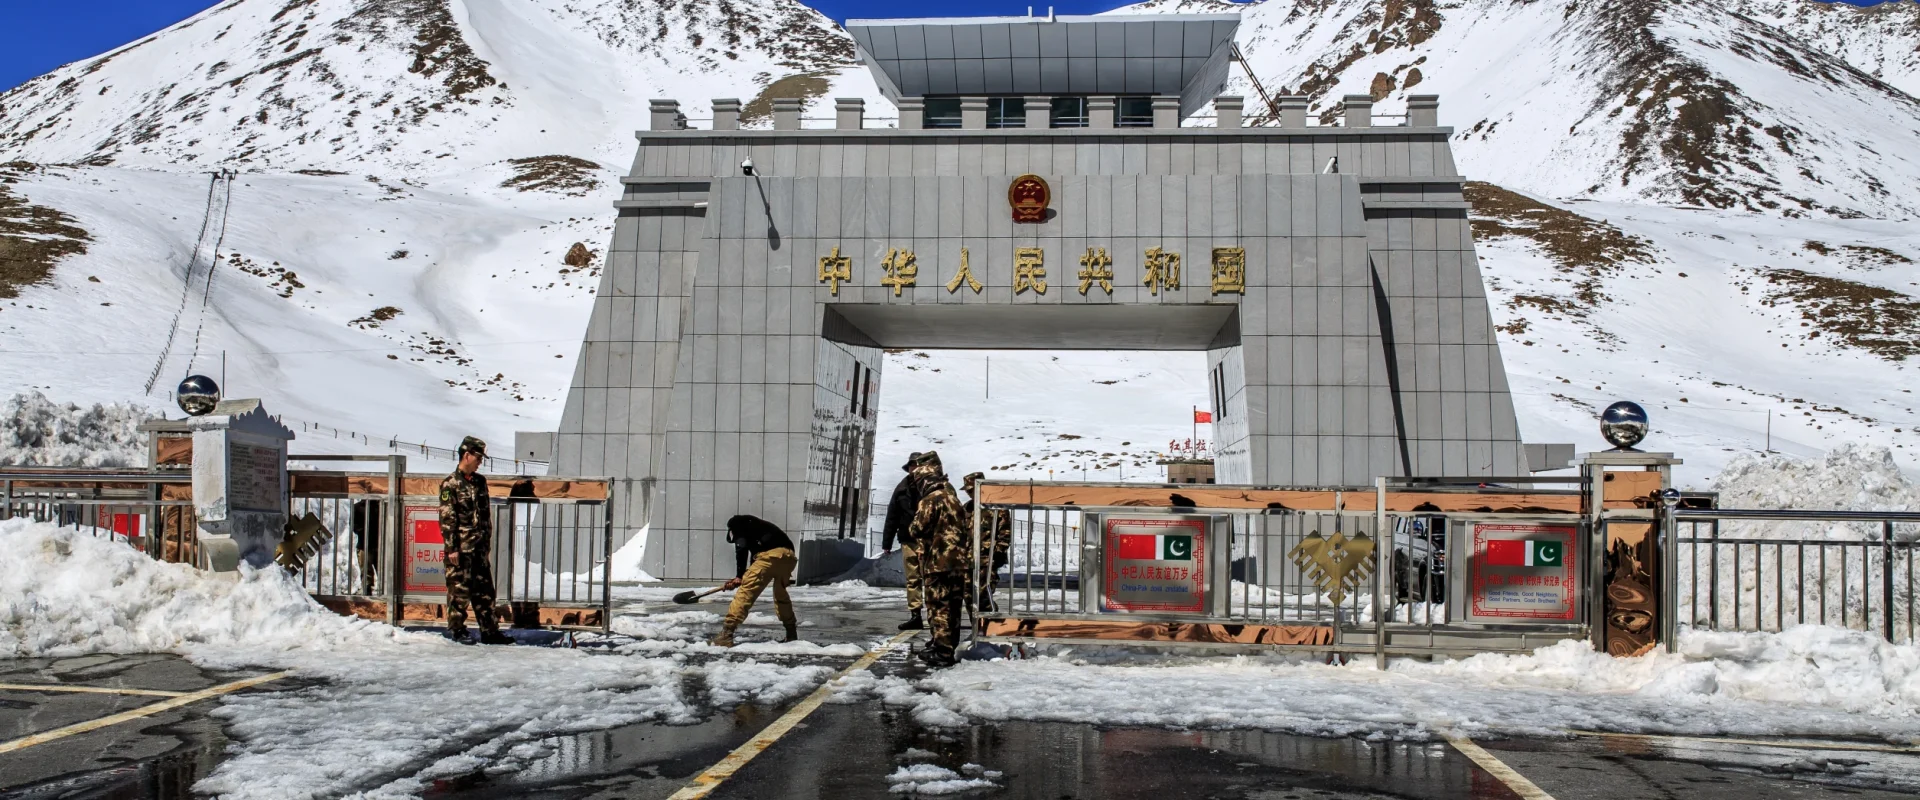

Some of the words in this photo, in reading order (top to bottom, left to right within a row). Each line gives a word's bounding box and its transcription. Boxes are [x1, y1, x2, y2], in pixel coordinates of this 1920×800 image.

[818, 246, 1245, 296] 中华人民共和国
[1169, 437, 1213, 454] 红其拉
[1121, 565, 1189, 580] 中巴人民友谊万岁
